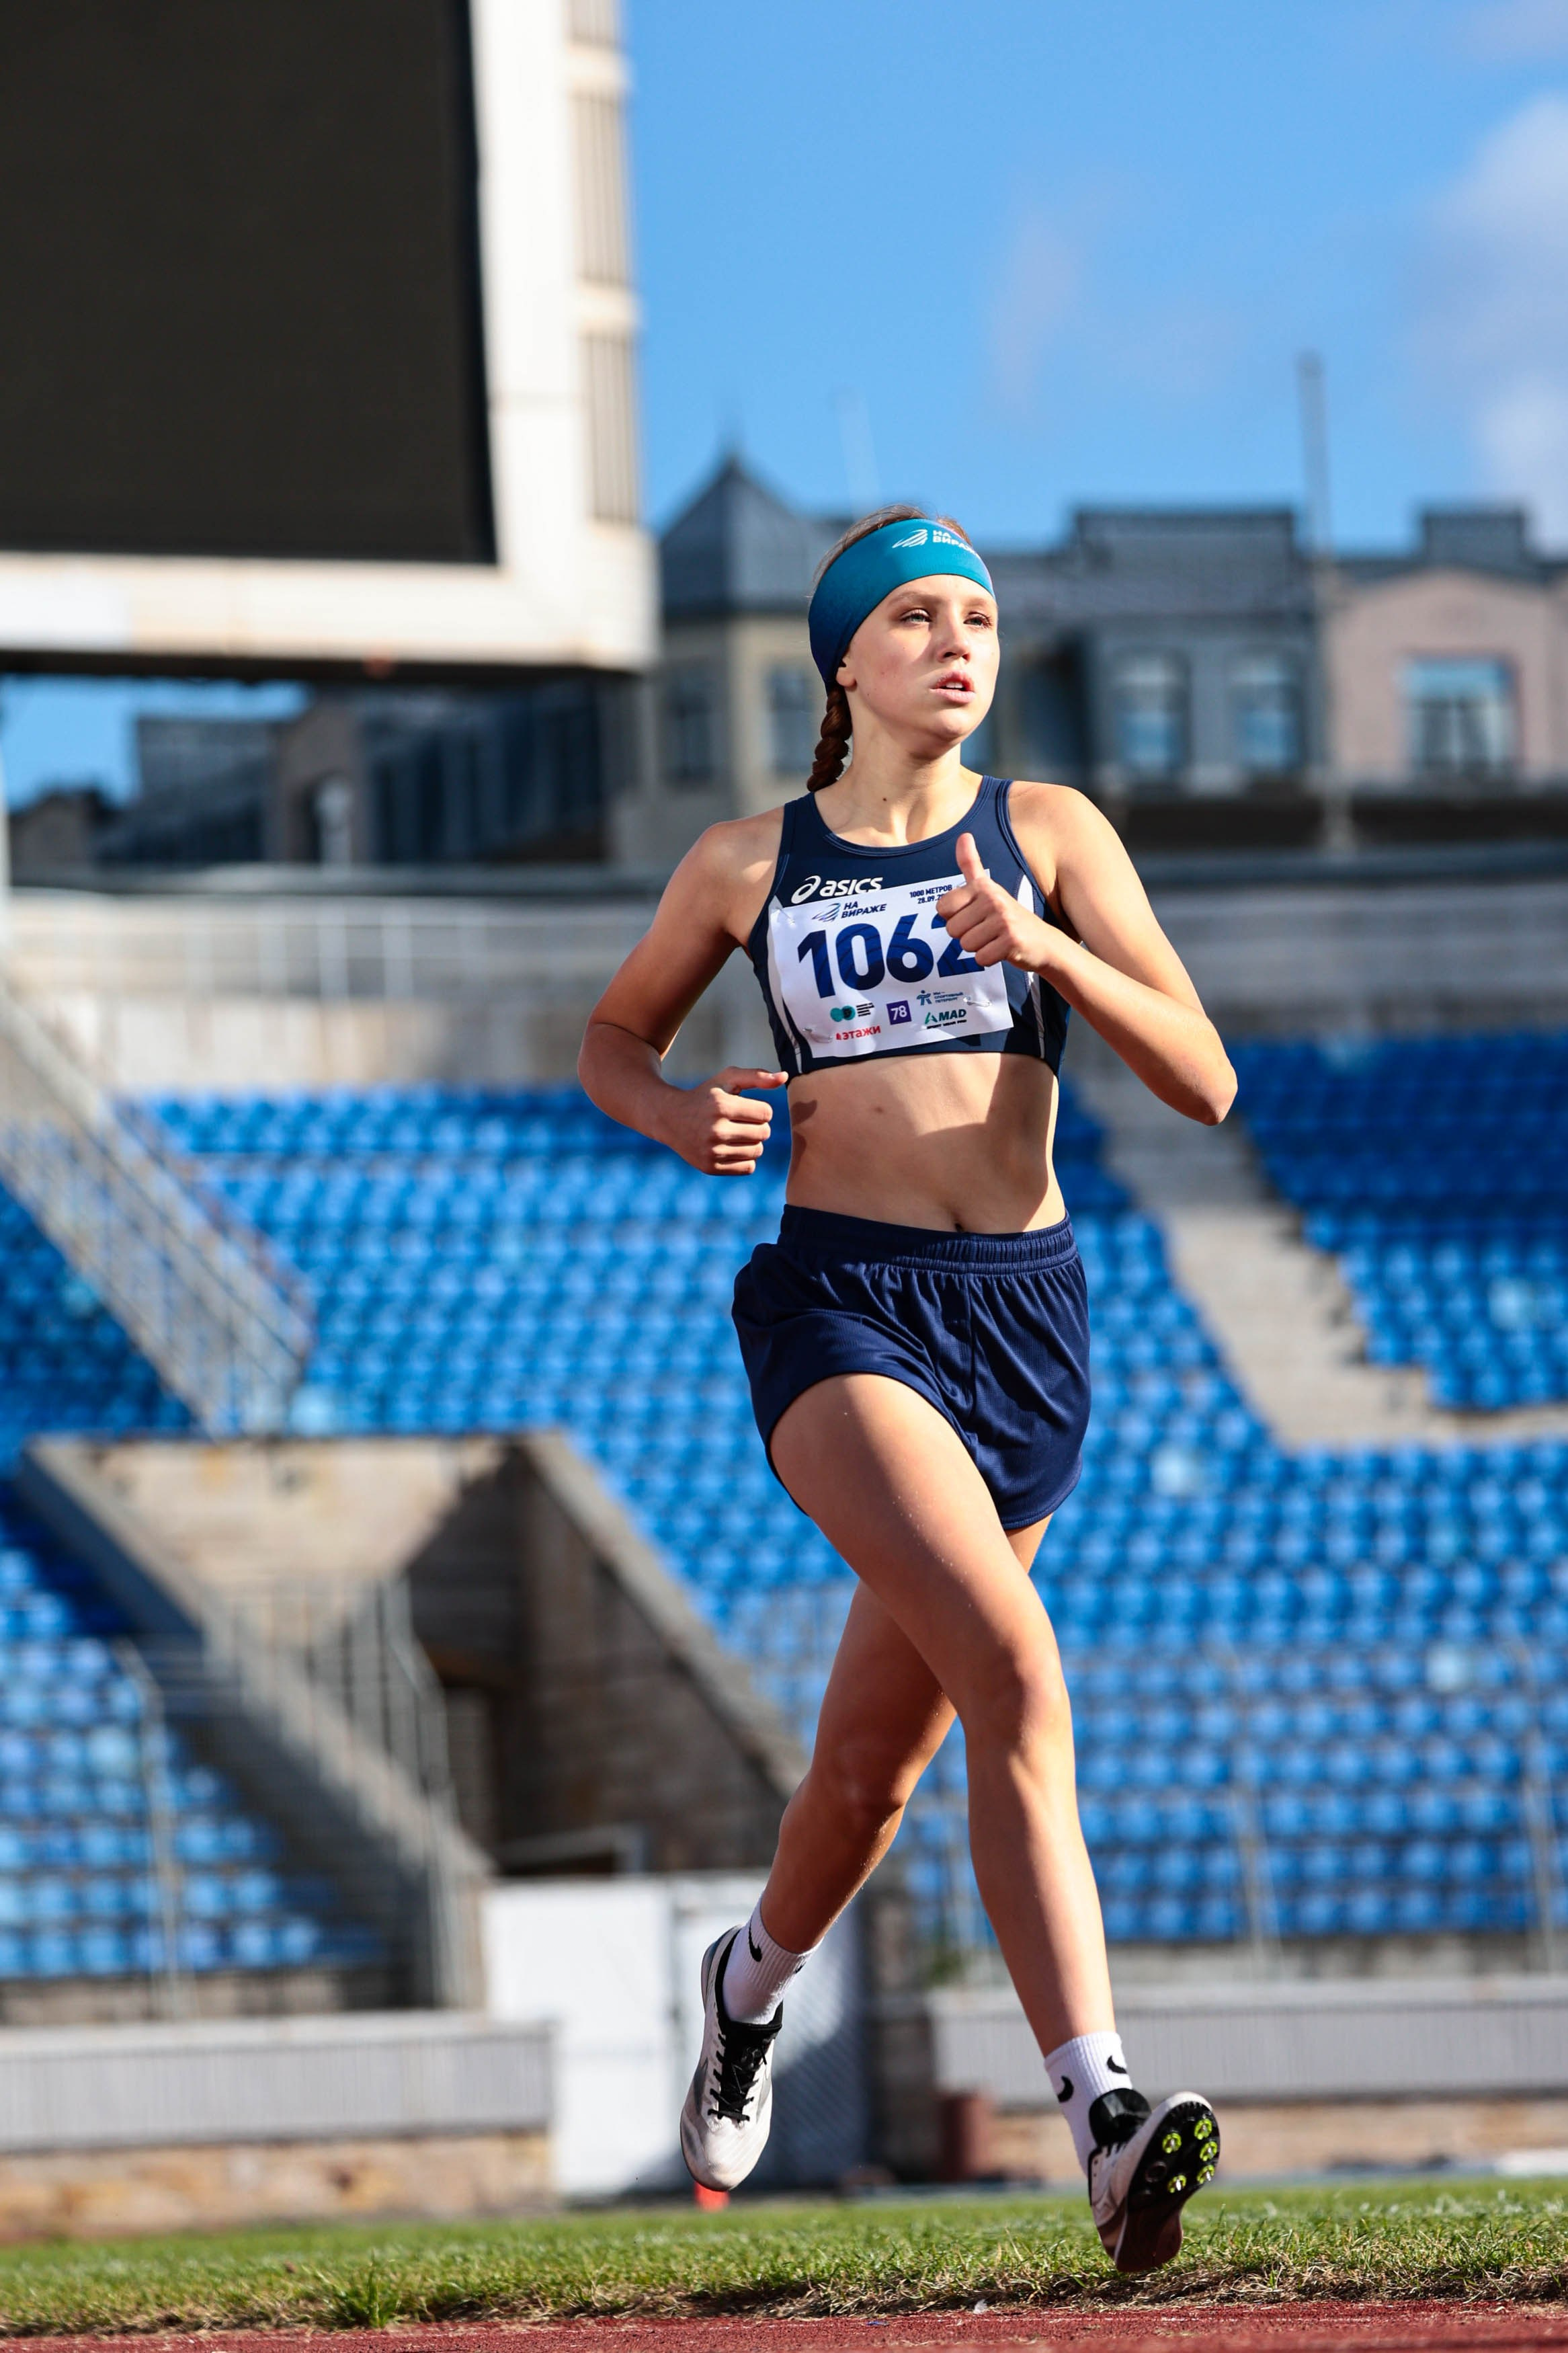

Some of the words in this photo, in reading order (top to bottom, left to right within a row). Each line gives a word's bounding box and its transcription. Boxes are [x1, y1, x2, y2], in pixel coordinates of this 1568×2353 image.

[933, 530, 951, 539] НА
[909, 889, 924, 898] 1000
[925, 884, 952, 895] МЕТРОВ
[841, 903, 887, 919] ВИРАЖЕ
[843, 901, 858, 910] НА
[891, 1005, 907, 1021] 78
